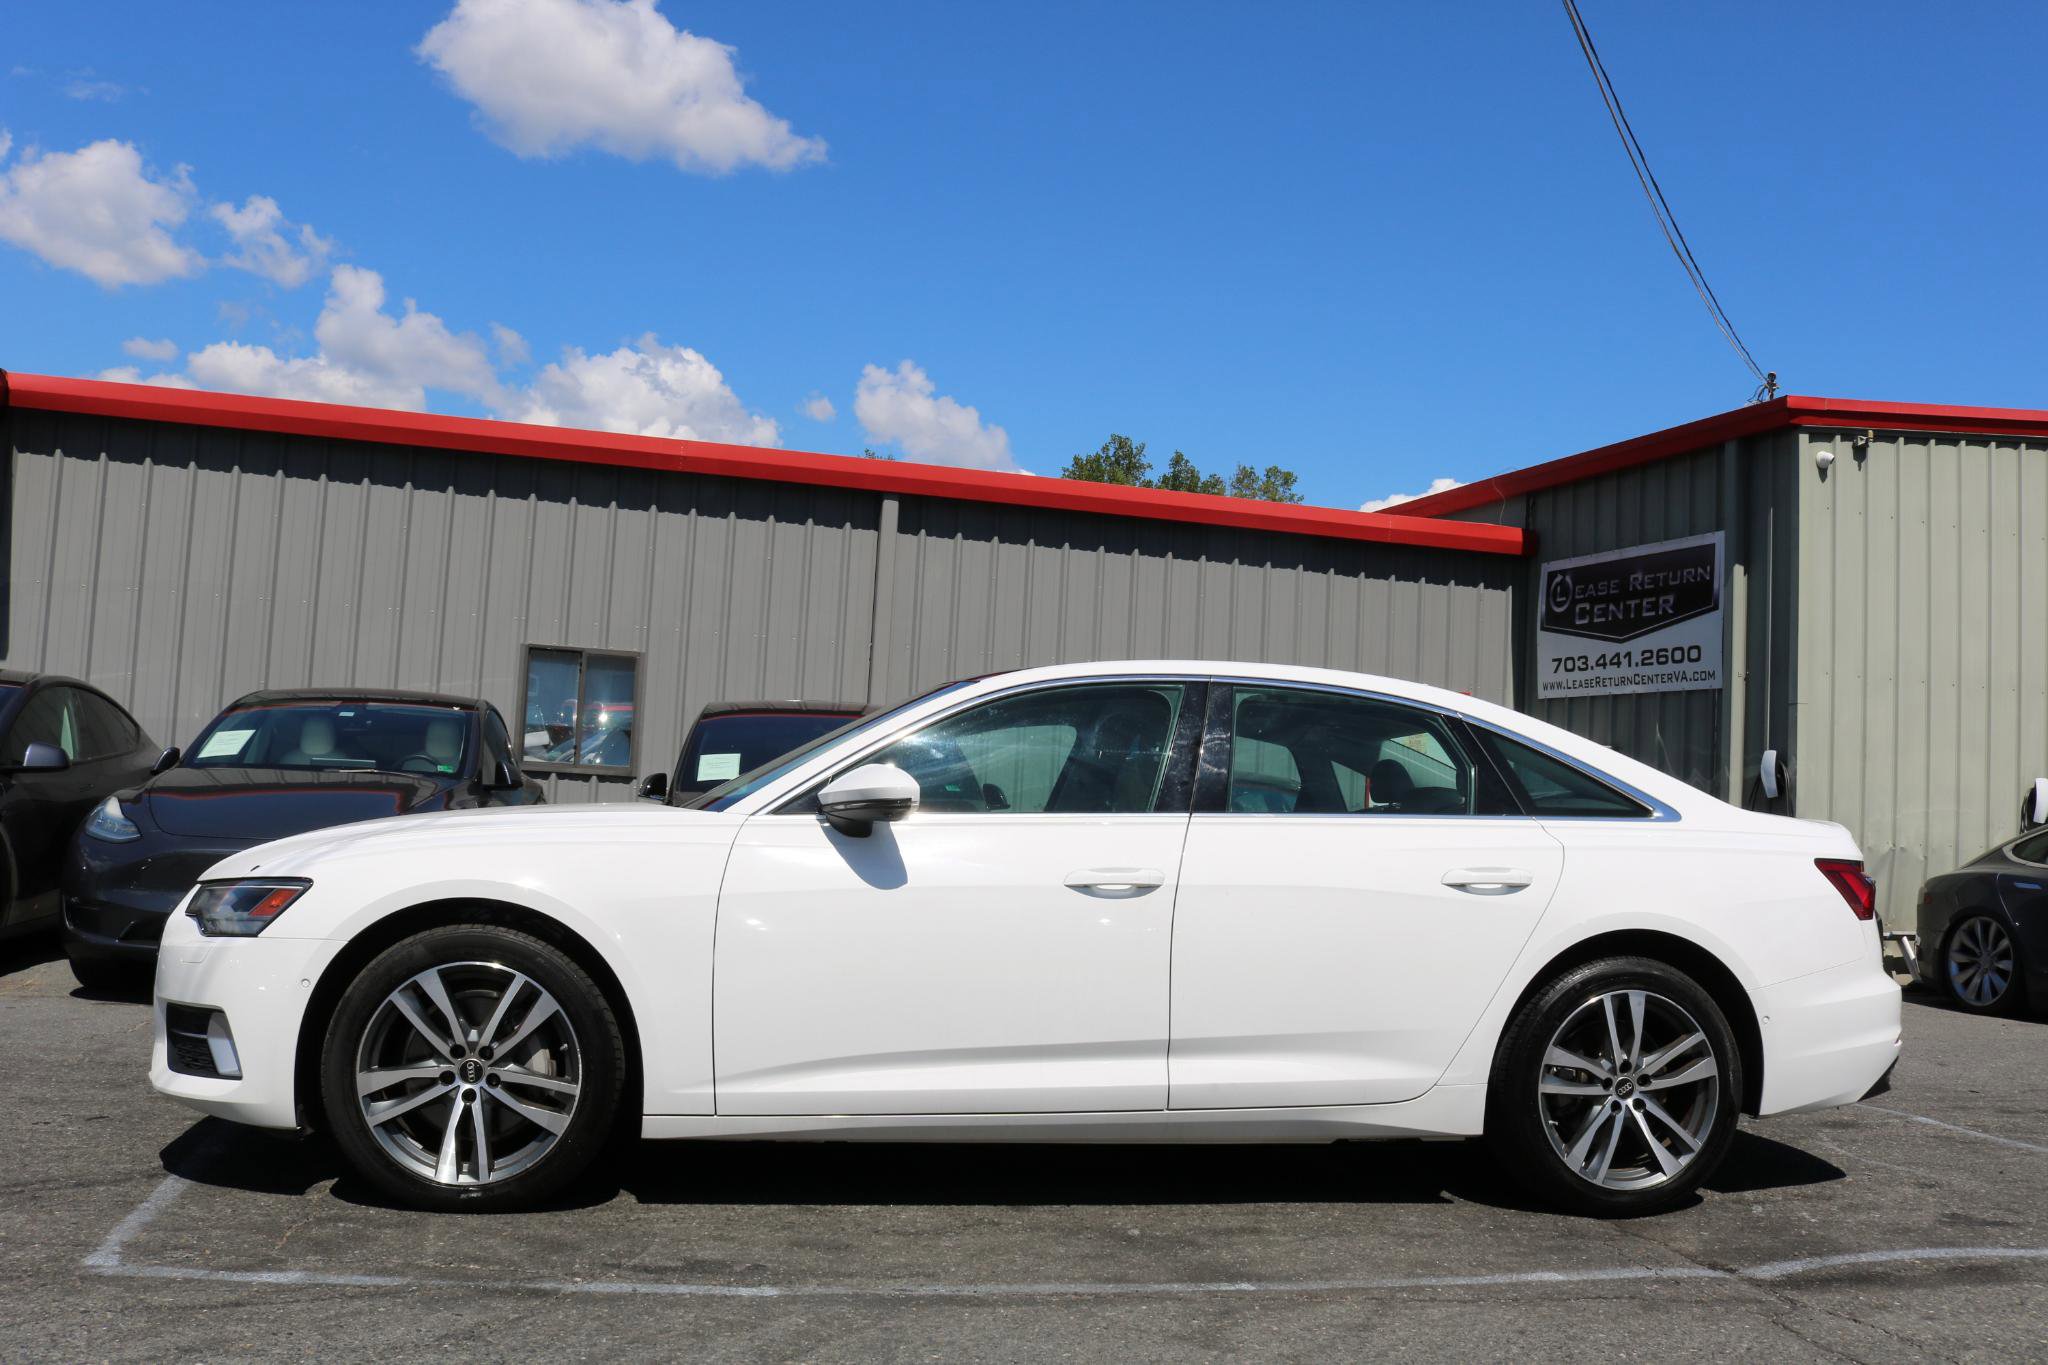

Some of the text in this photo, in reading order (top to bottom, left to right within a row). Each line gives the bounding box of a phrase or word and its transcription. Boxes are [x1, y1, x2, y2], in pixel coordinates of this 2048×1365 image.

[1629, 566, 1711, 592] RETURN
[1575, 595, 1674, 625] CENTER
[1552, 645, 1702, 673] 703.441.2600
